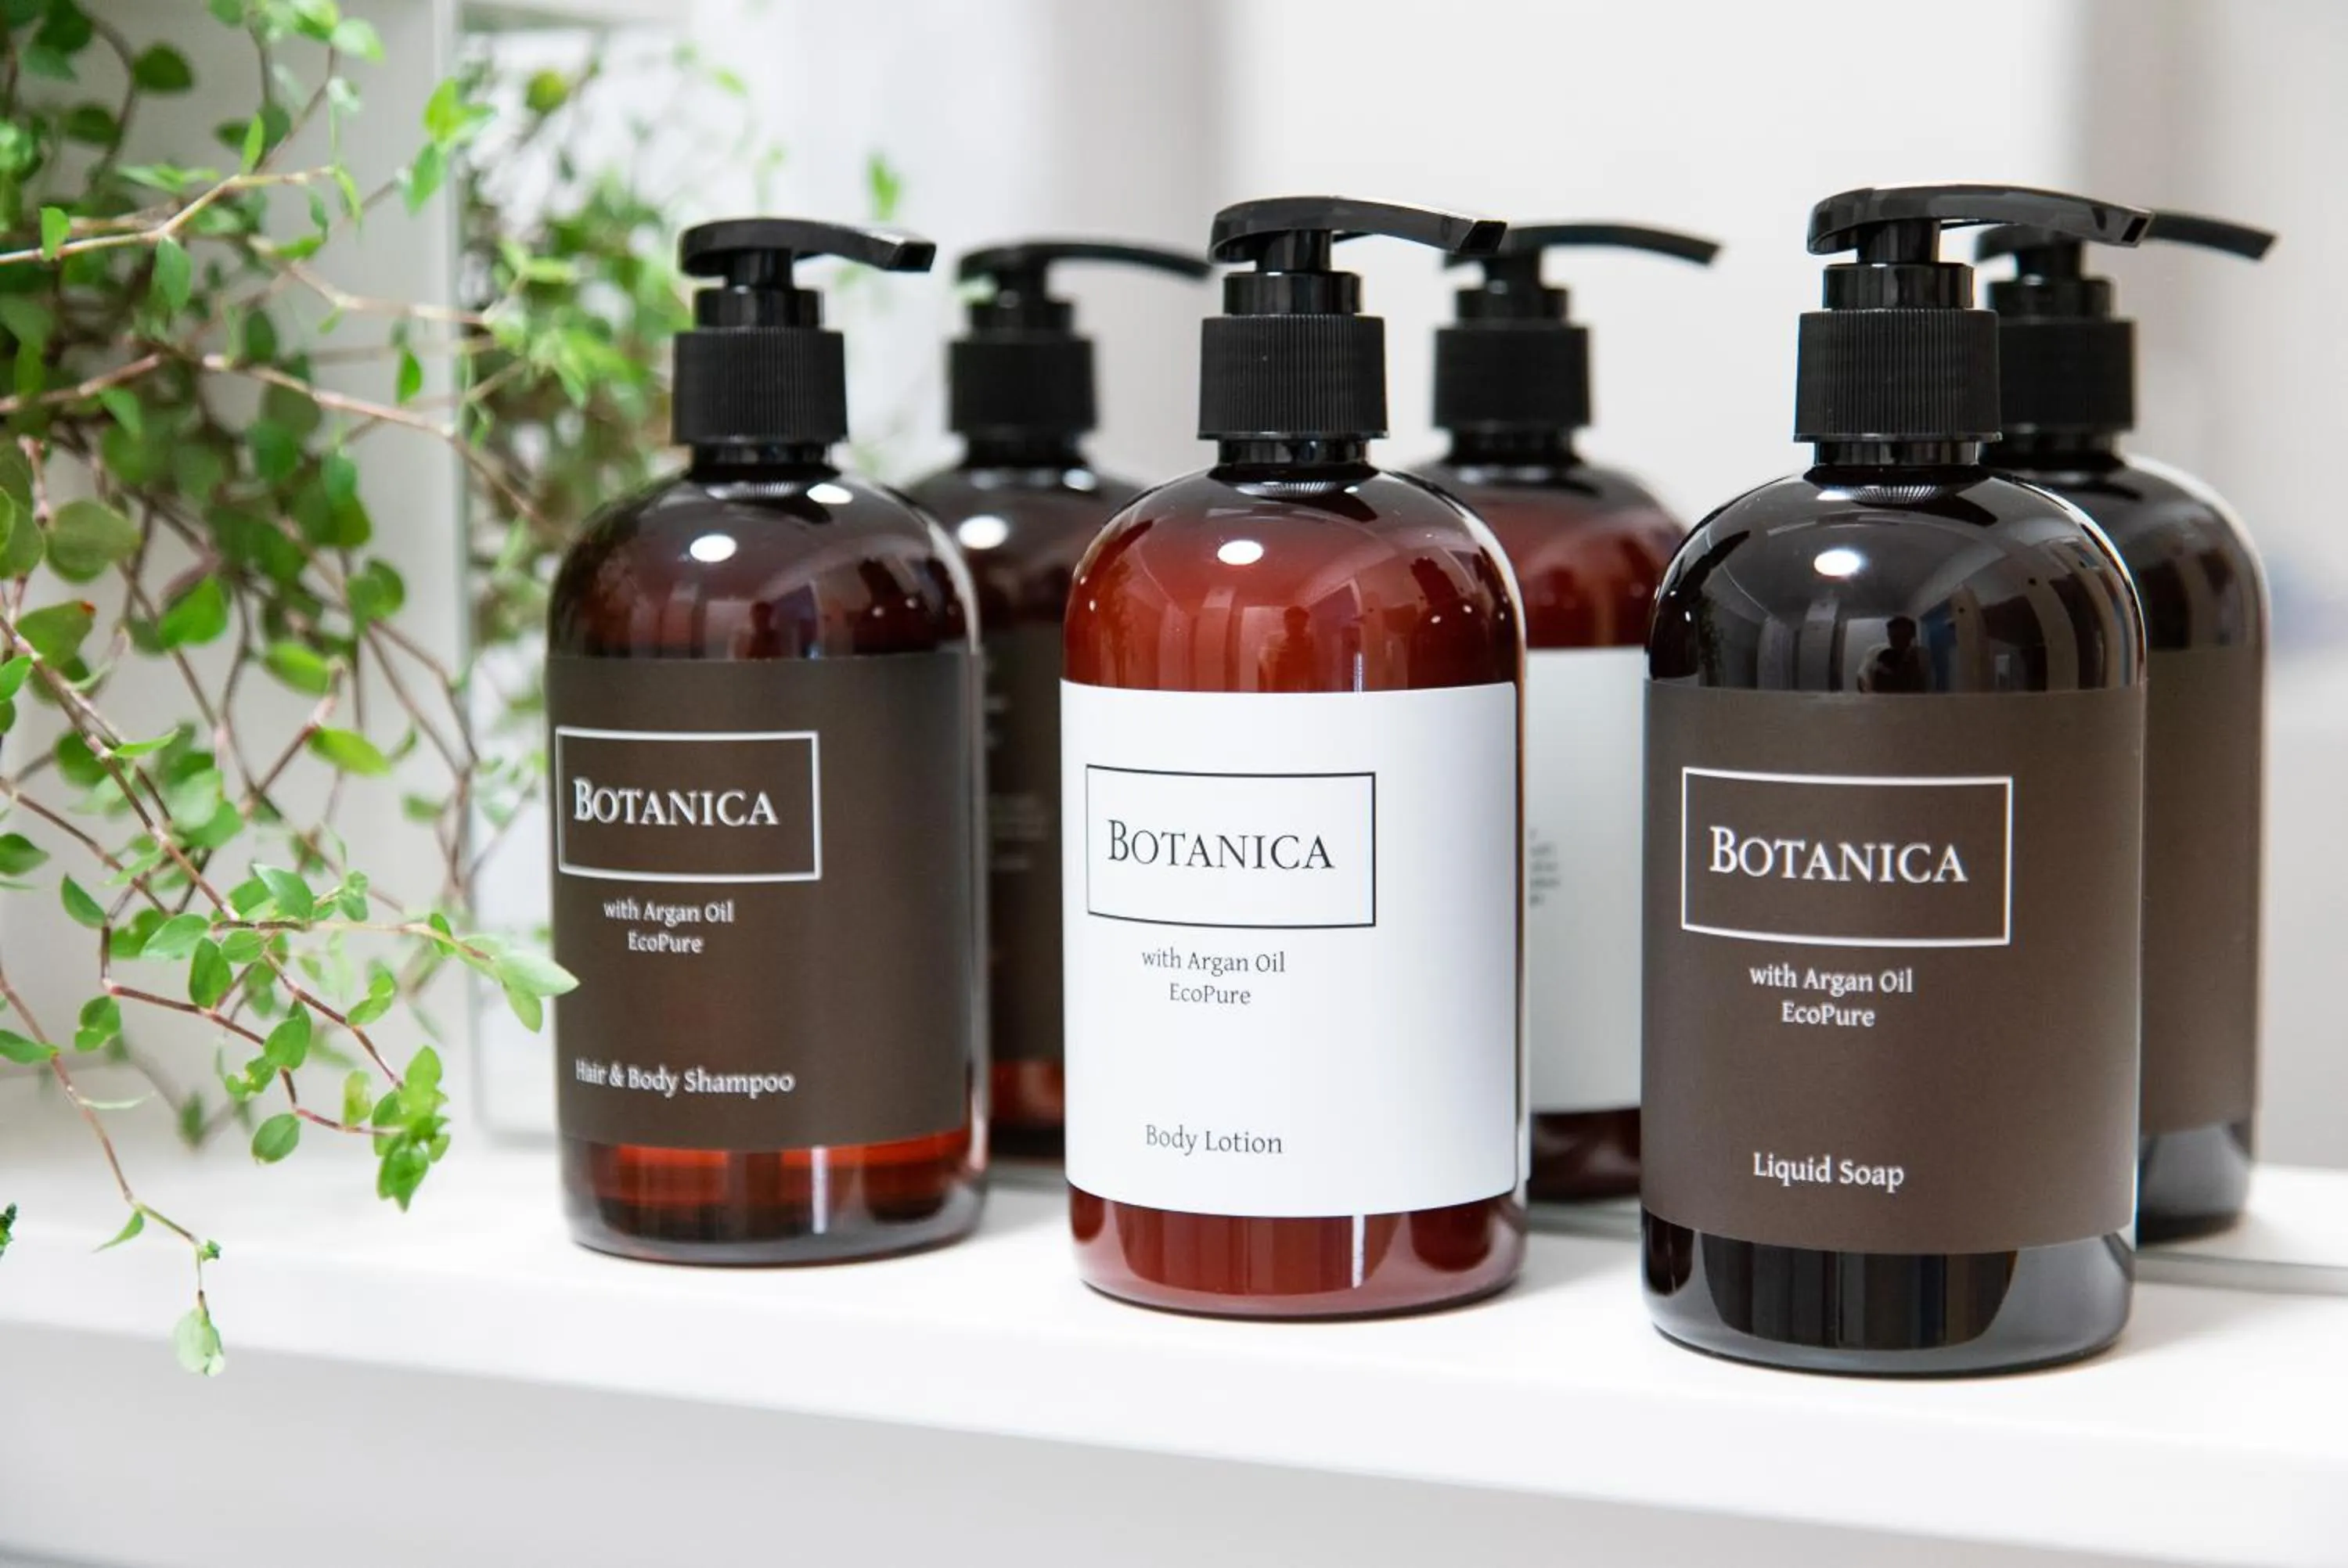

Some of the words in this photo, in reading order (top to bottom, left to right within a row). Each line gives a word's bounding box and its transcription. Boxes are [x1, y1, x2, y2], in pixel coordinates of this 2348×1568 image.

[572, 777, 780, 826] BOTANICA
[1107, 818, 1336, 871] BOTANICA
[1709, 825, 1969, 883] BOTANICA
[603, 897, 639, 920] with
[643, 901, 700, 927] Argan
[705, 899, 734, 923] Oil
[628, 930, 704, 953] EcoPure
[1142, 948, 1182, 970] with
[1187, 951, 1249, 976] Argan
[1255, 951, 1286, 973] Oil
[1169, 983, 1251, 1005] EcoPure
[1749, 962, 1797, 989] with
[1802, 967, 1874, 998] Argan
[1879, 967, 1914, 994] Oil
[1781, 1002, 1876, 1027] EcoPure
[575, 1058, 607, 1085] Hair
[609, 1062, 625, 1088] &
[628, 1065, 679, 1098] Body
[684, 1066, 796, 1099] Shampoo
[1145, 1124, 1197, 1156] Body
[1205, 1130, 1283, 1154] Lotion
[1752, 1151, 1832, 1187] Liquid
[1839, 1159, 1905, 1193] Soap
